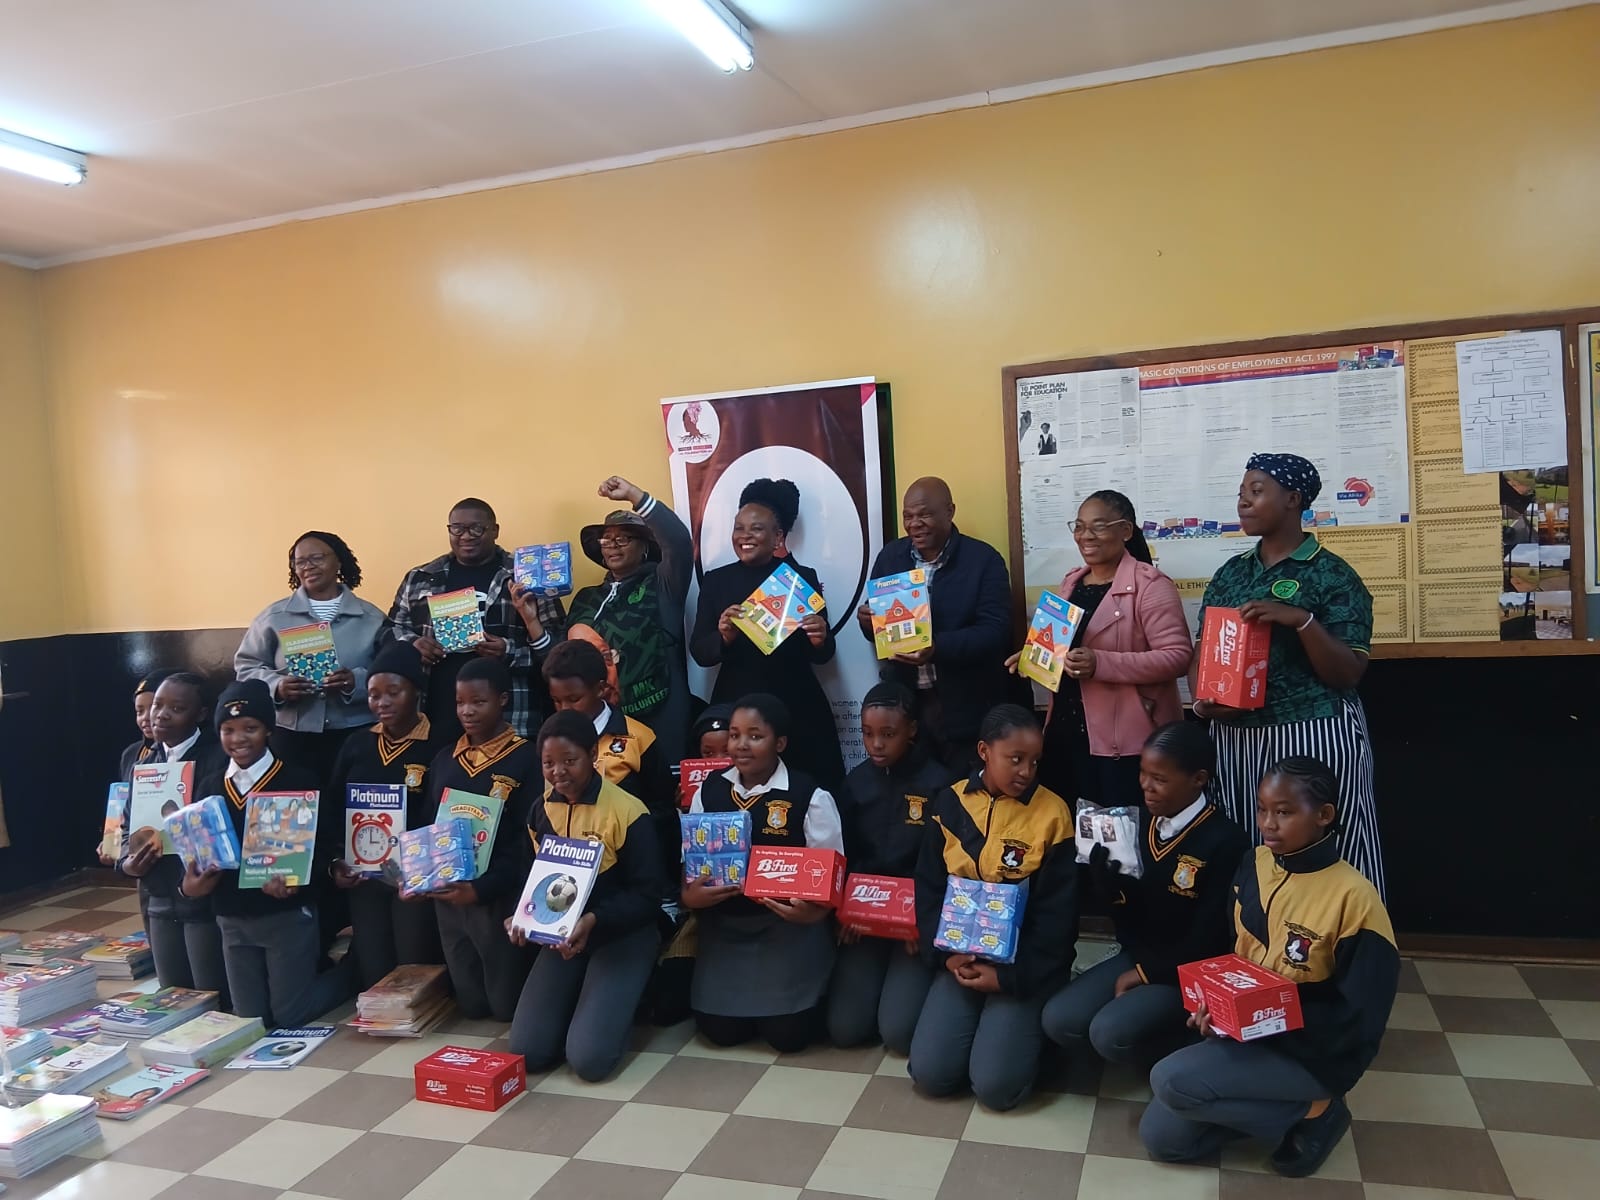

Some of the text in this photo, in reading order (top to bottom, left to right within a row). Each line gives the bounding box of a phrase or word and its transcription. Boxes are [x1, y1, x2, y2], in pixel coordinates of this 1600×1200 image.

[1163, 363, 1216, 376] CONDITIONS
[1217, 362, 1230, 371] OF
[1231, 356, 1292, 369] EMPLOYMENT
[1316, 352, 1337, 361] 1997
[1029, 383, 1048, 391] POINT
[1034, 387, 1068, 396] EDUCATION
[350, 788, 400, 803] Platinum
[541, 838, 597, 862] Platinum
[271, 1028, 330, 1037] Platinum
